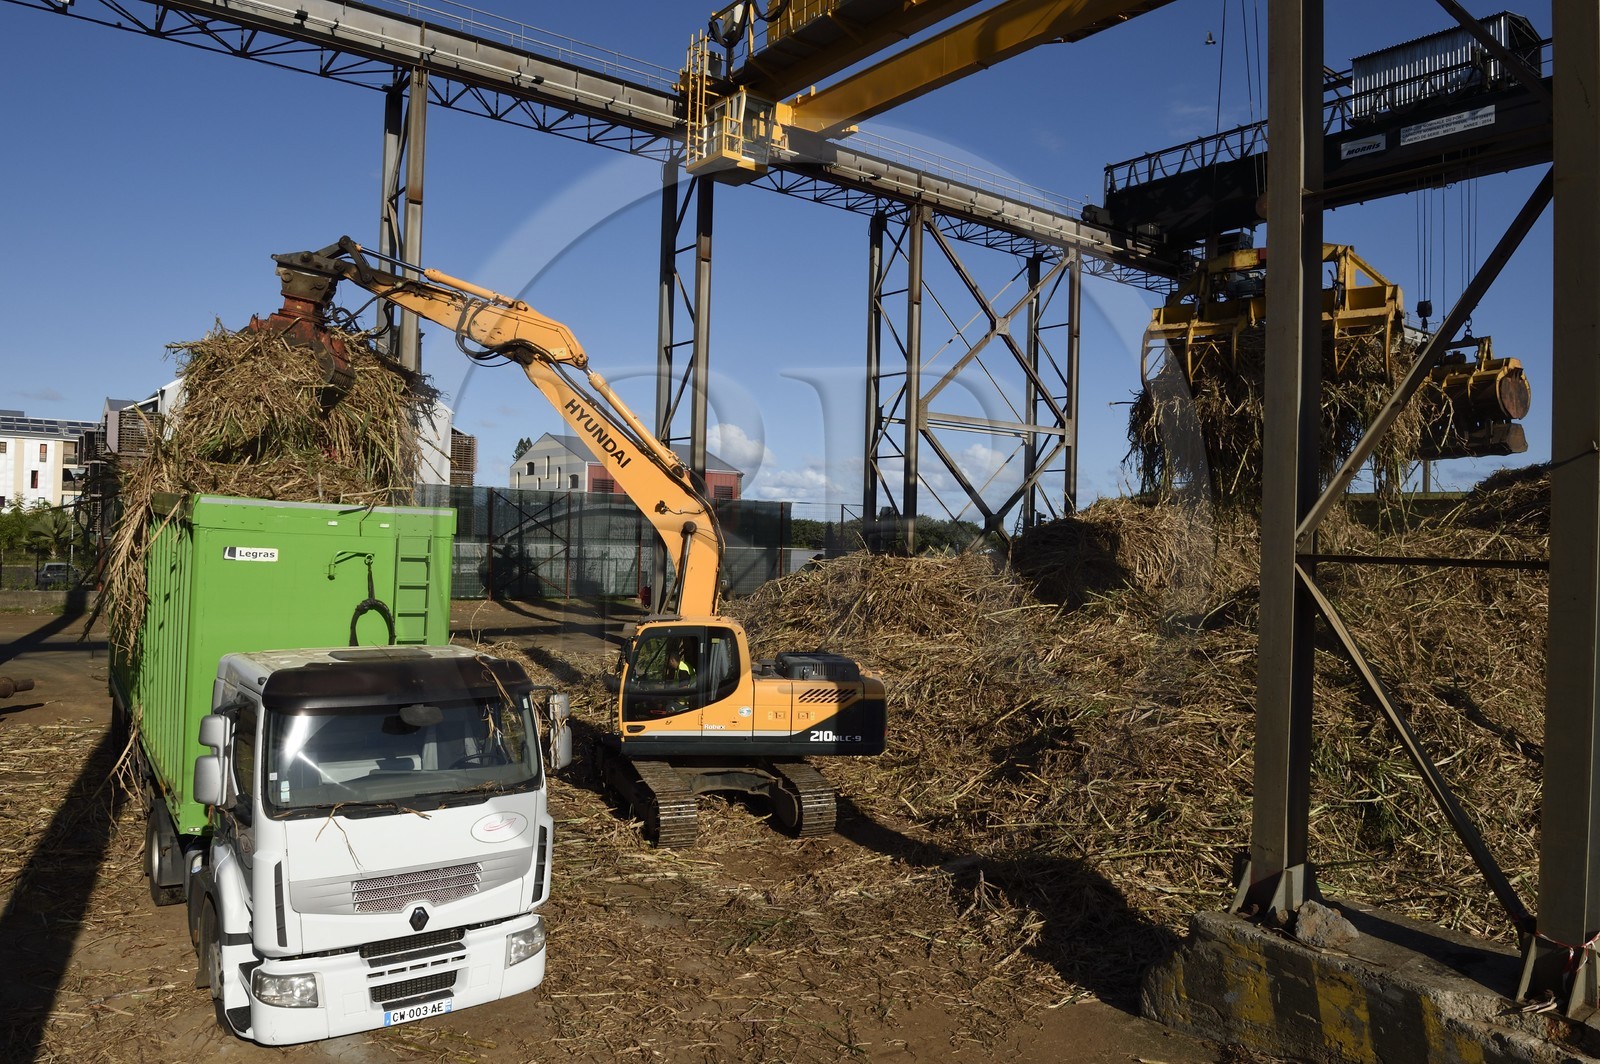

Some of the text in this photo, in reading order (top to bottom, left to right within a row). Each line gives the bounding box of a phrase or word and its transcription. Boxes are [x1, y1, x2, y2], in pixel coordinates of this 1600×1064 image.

[1346, 142, 1381, 156] MORRIS
[564, 398, 632, 469] HYUNDAI
[239, 550, 275, 559] Legras
